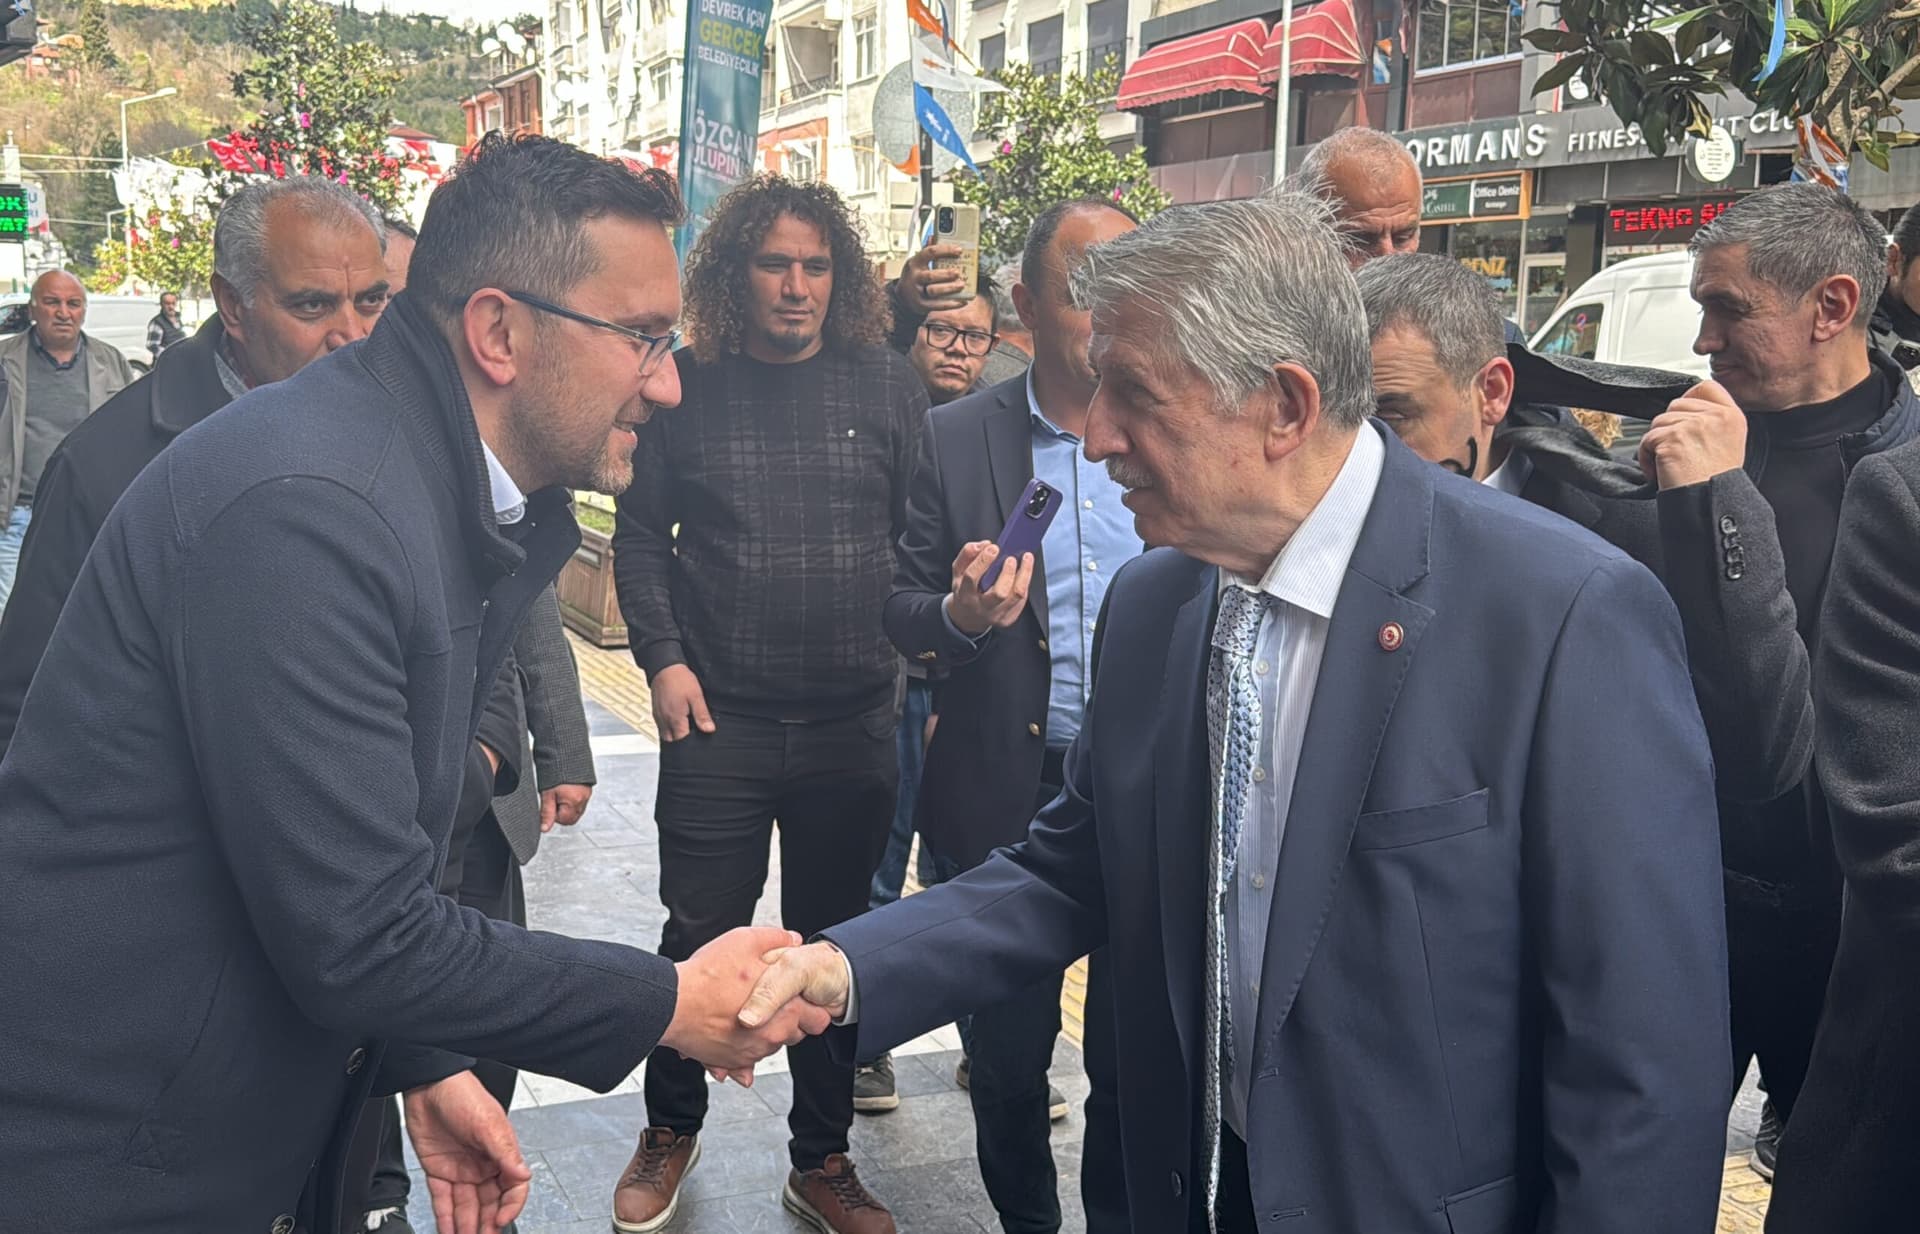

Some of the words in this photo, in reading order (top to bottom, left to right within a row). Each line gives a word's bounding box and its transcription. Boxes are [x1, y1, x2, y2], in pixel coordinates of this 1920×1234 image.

[702, 0, 745, 23] DEVREK
[700, 18, 762, 60] GERÇEK
[695, 109, 754, 164] ÖZCAN
[1405, 124, 1547, 168] ORMANS
[1567, 125, 1648, 152] FITNES
[1610, 207, 1694, 232] TEKNO
